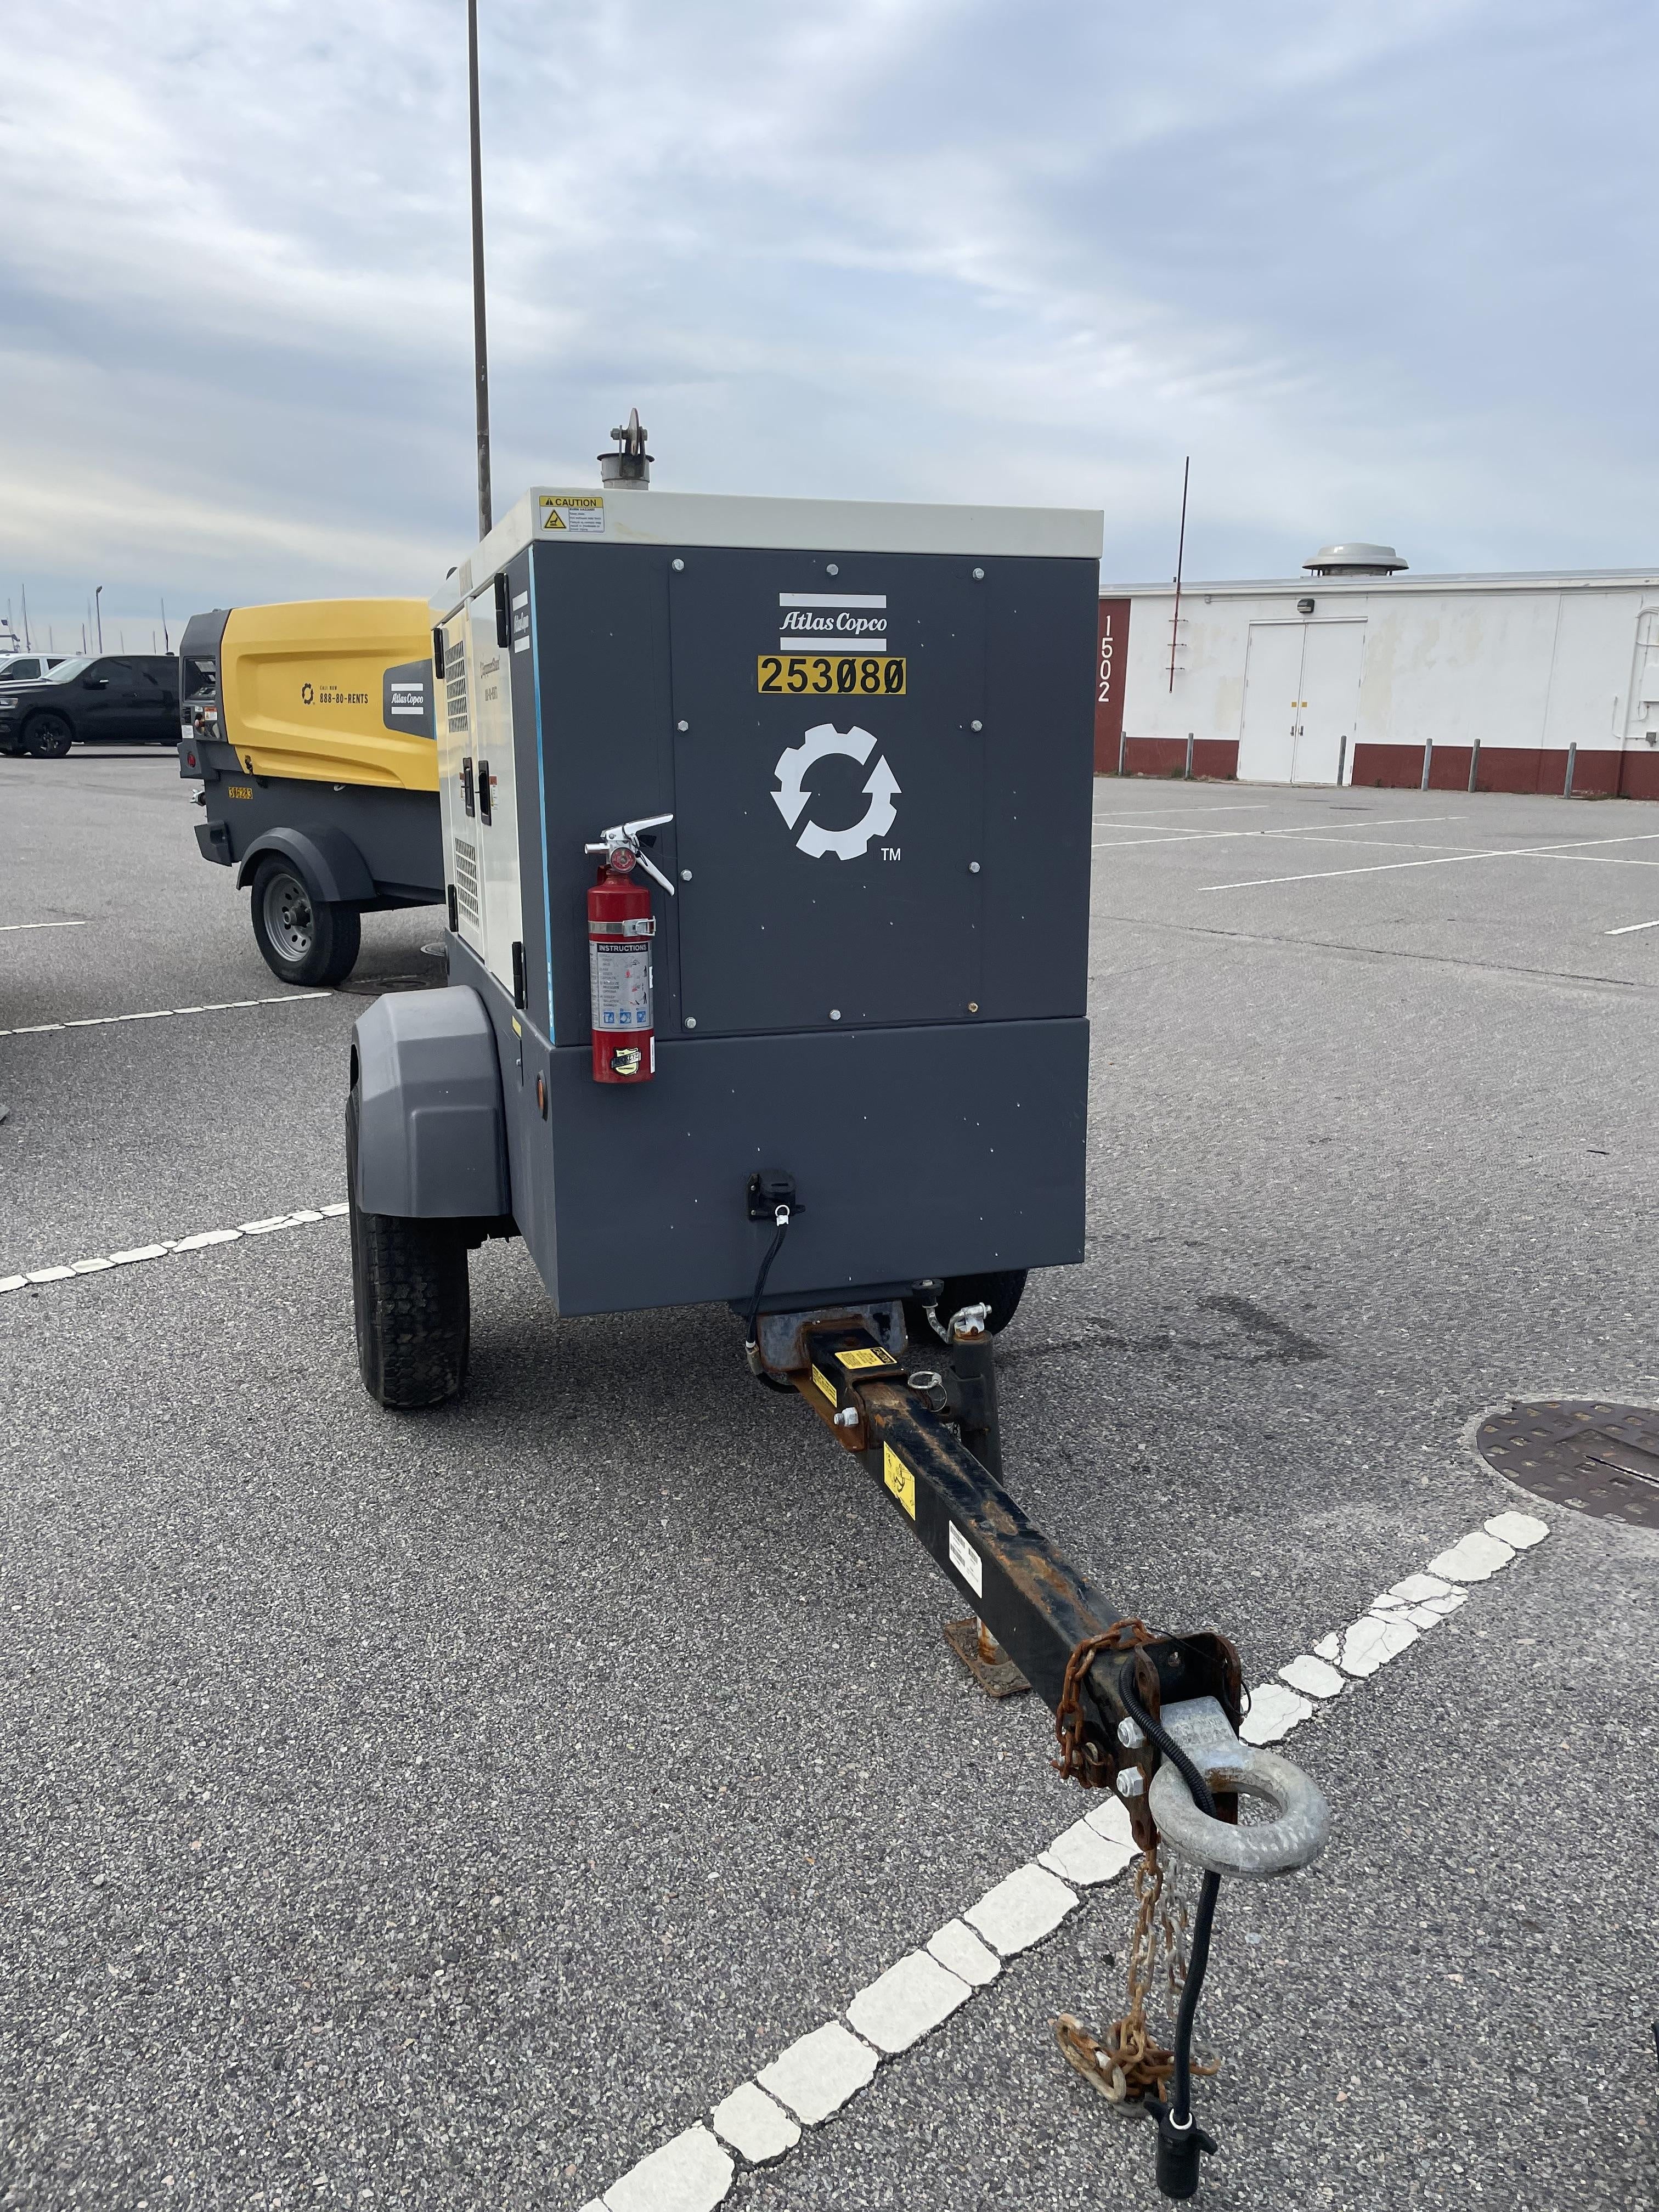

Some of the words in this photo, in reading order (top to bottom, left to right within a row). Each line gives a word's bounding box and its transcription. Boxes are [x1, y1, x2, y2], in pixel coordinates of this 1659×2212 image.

[1098, 615, 1113, 702] 1502
[761, 658, 904, 693] 253080
[320, 693, 368, 703] 888-80-RENTS
[881, 848, 901, 861] TM
[599, 944, 647, 952] INSTRUCTIONS
